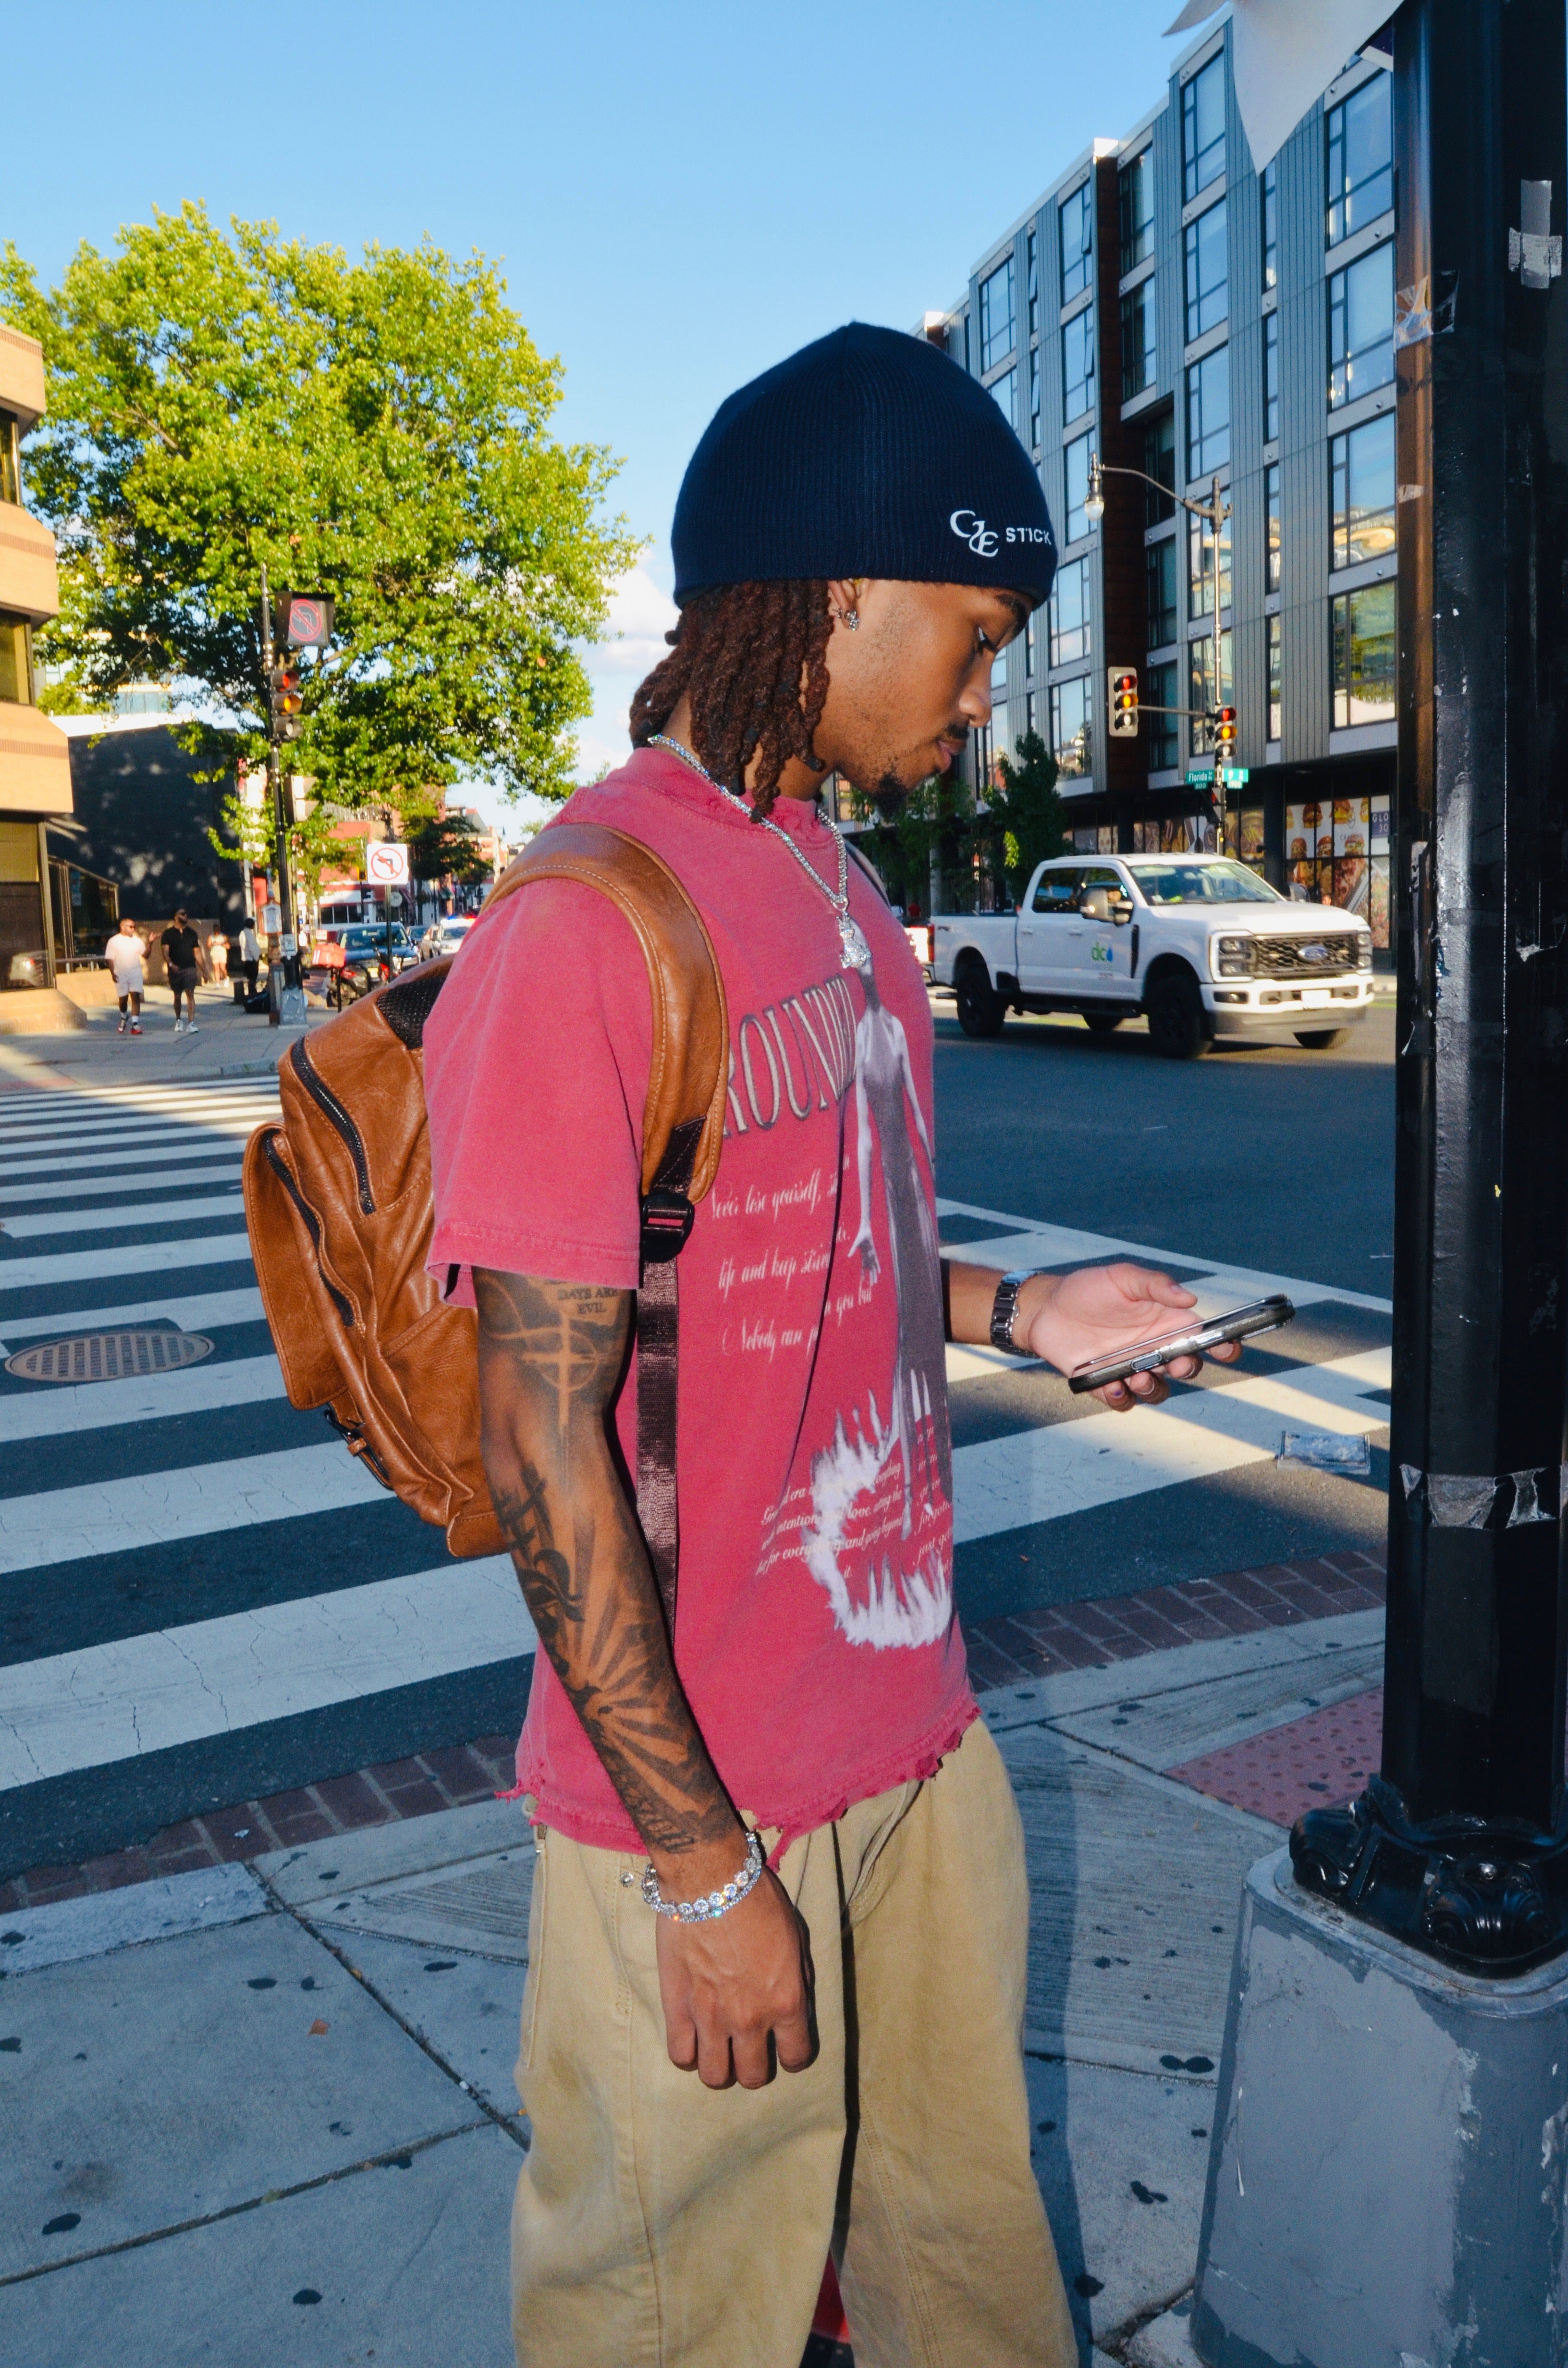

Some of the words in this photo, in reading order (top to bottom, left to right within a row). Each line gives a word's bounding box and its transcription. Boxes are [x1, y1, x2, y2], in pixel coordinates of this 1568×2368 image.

[1188, 772, 1207, 782] Florida
[742, 1249, 769, 1283] and
[780, 1329, 803, 1346] can
